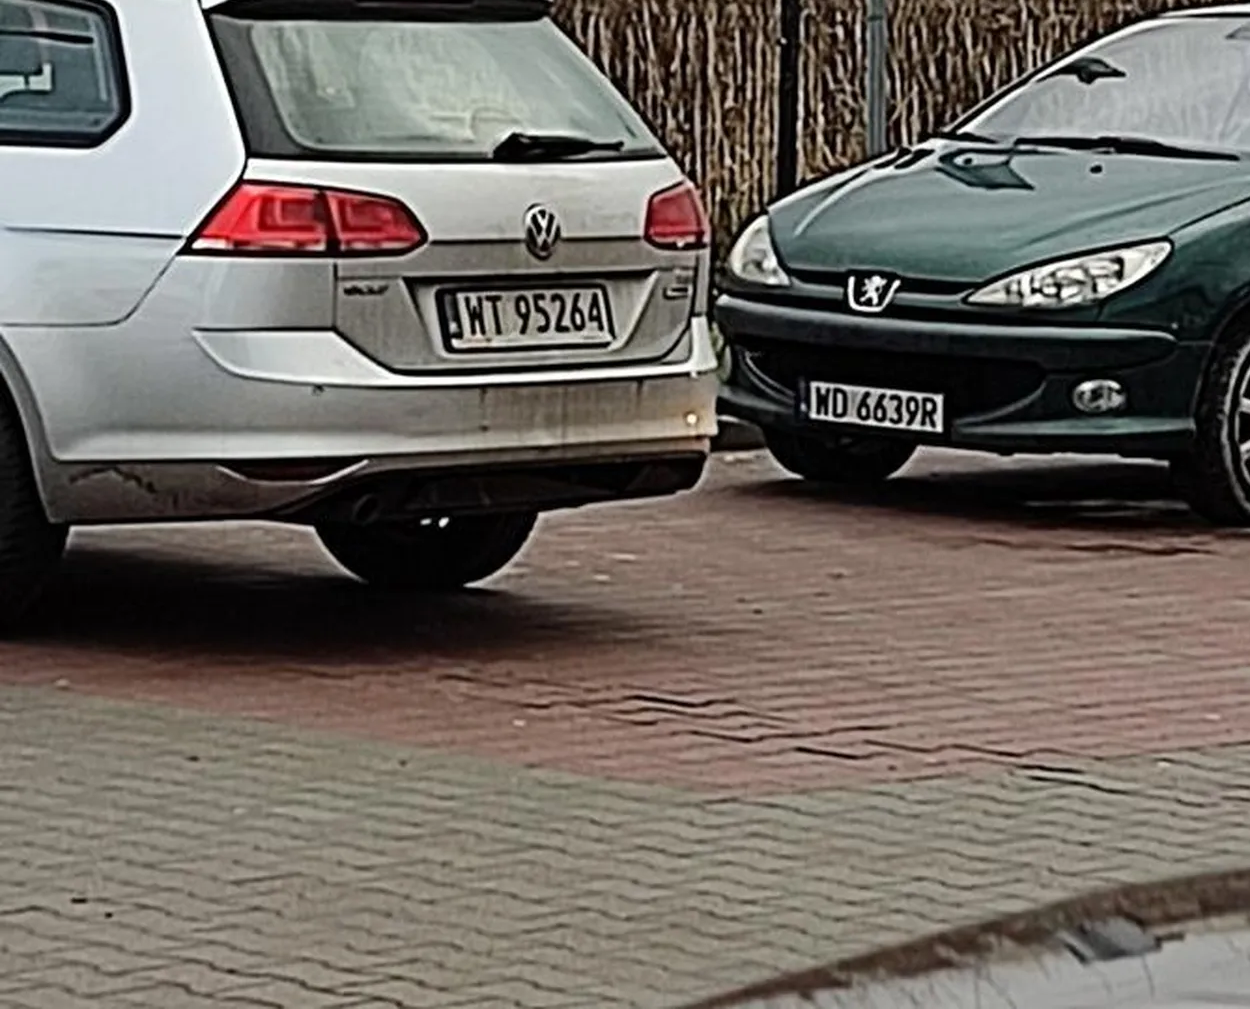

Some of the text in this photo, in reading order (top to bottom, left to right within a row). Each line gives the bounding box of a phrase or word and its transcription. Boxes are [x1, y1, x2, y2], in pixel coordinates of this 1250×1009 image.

[463, 292, 604, 336] WT 95264
[815, 386, 937, 428] WD 6639R
